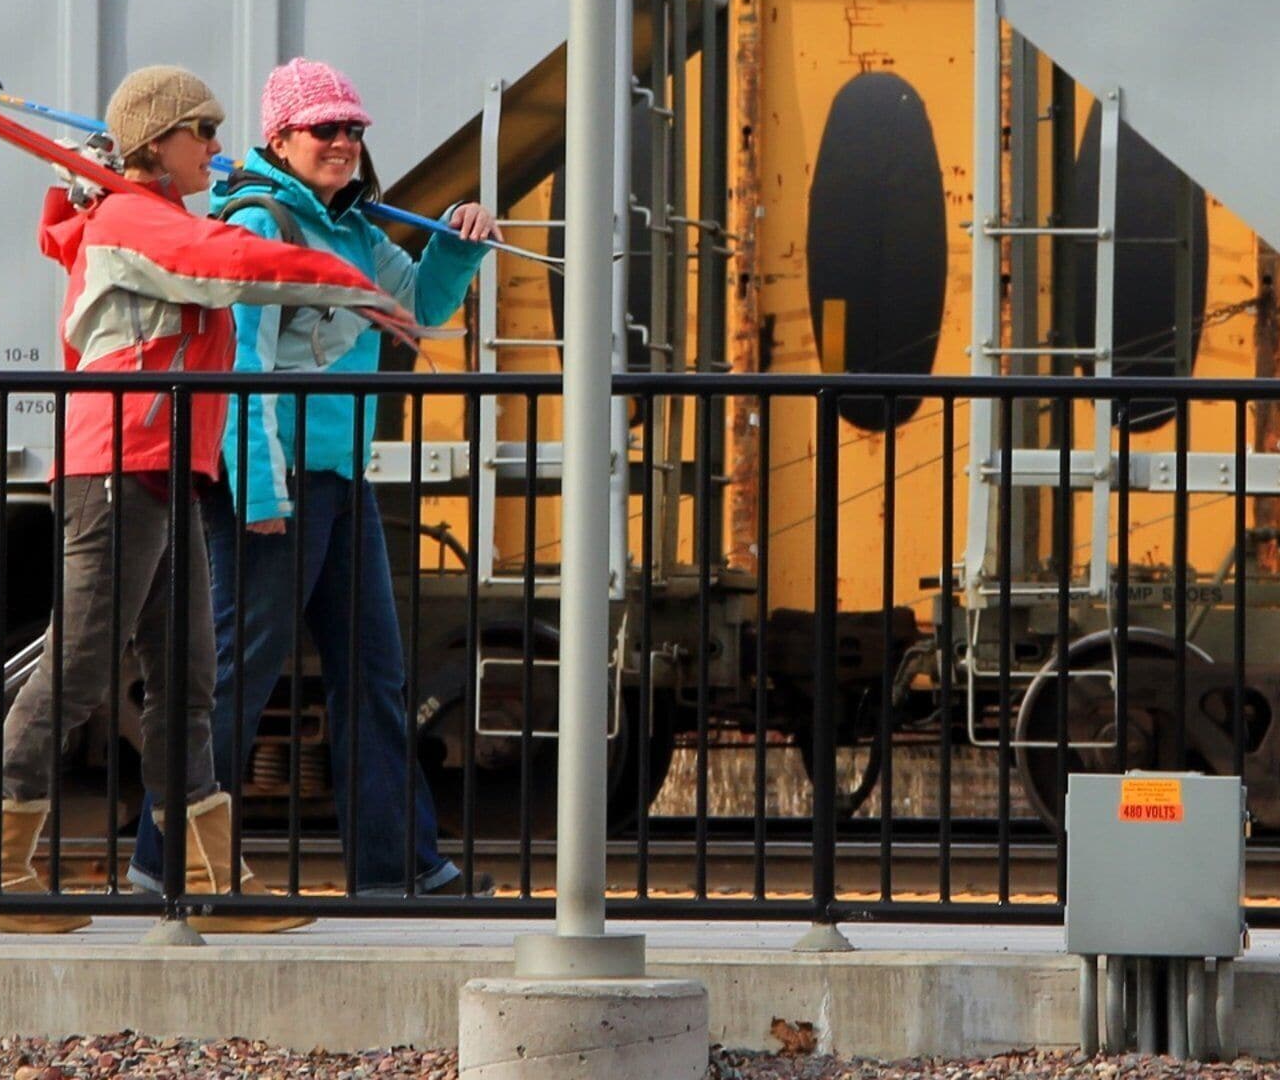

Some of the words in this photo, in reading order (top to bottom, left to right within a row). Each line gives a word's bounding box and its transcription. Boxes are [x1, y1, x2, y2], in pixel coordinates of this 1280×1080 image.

[5, 347, 40, 362] 10-8
[15, 399, 55, 414] 4750
[1123, 804, 1142, 818] 480
[1145, 804, 1176, 819] VOLTS
